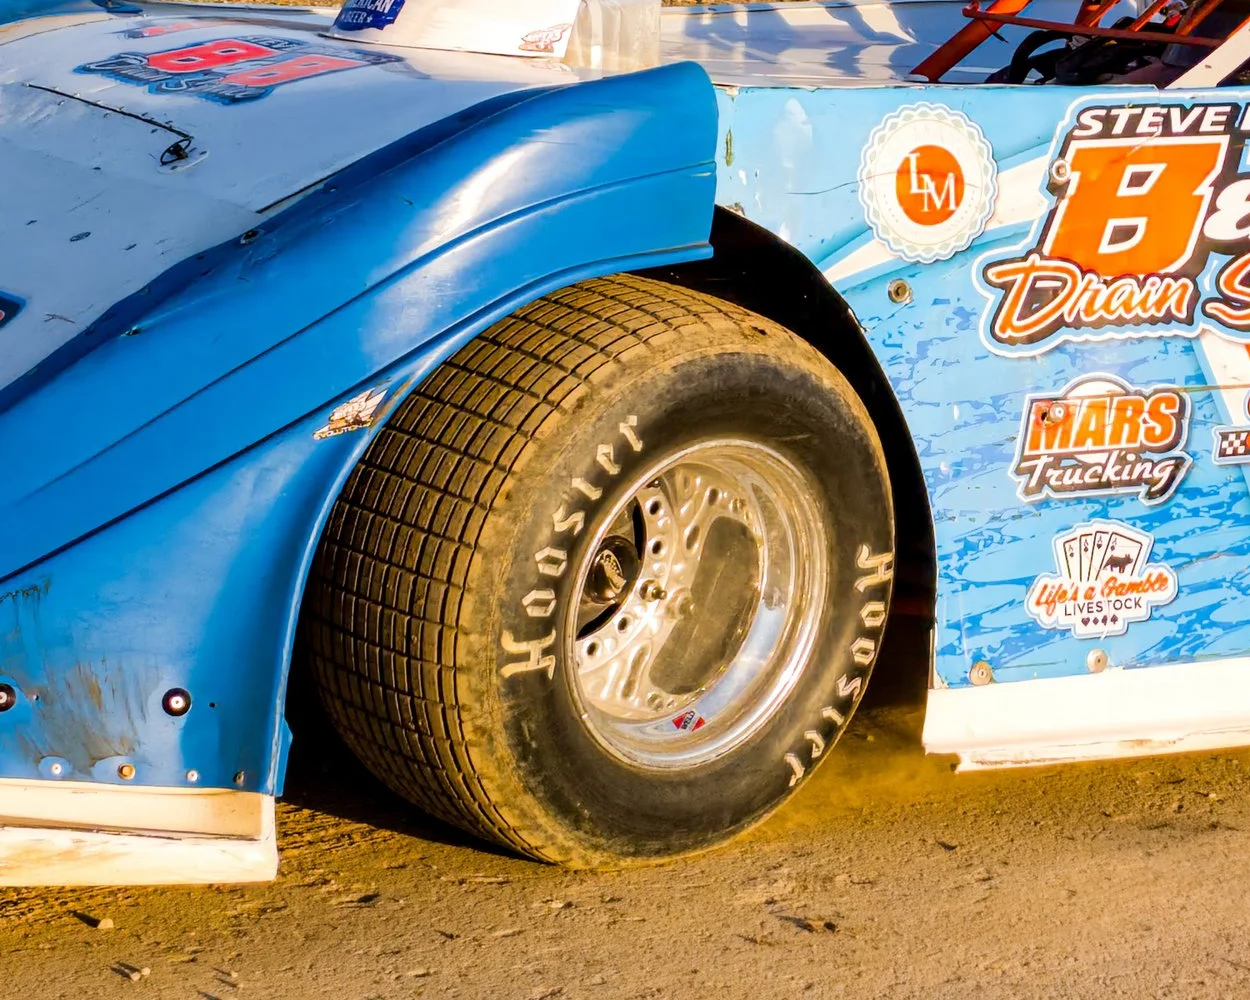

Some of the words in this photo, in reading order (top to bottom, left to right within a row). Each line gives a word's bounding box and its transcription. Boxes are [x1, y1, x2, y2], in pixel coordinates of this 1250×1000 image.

[1071, 101, 1228, 138] STEVE
[986, 254, 1195, 339] Drain
[1027, 392, 1180, 456] MARS
[500, 413, 647, 681] Hoosier
[1034, 582, 1080, 617] Life's
[1083, 586, 1097, 601] a
[1100, 572, 1169, 599] Gamble
[1064, 596, 1143, 617] LIVESTOCK
[781, 541, 895, 788] Hoosier
